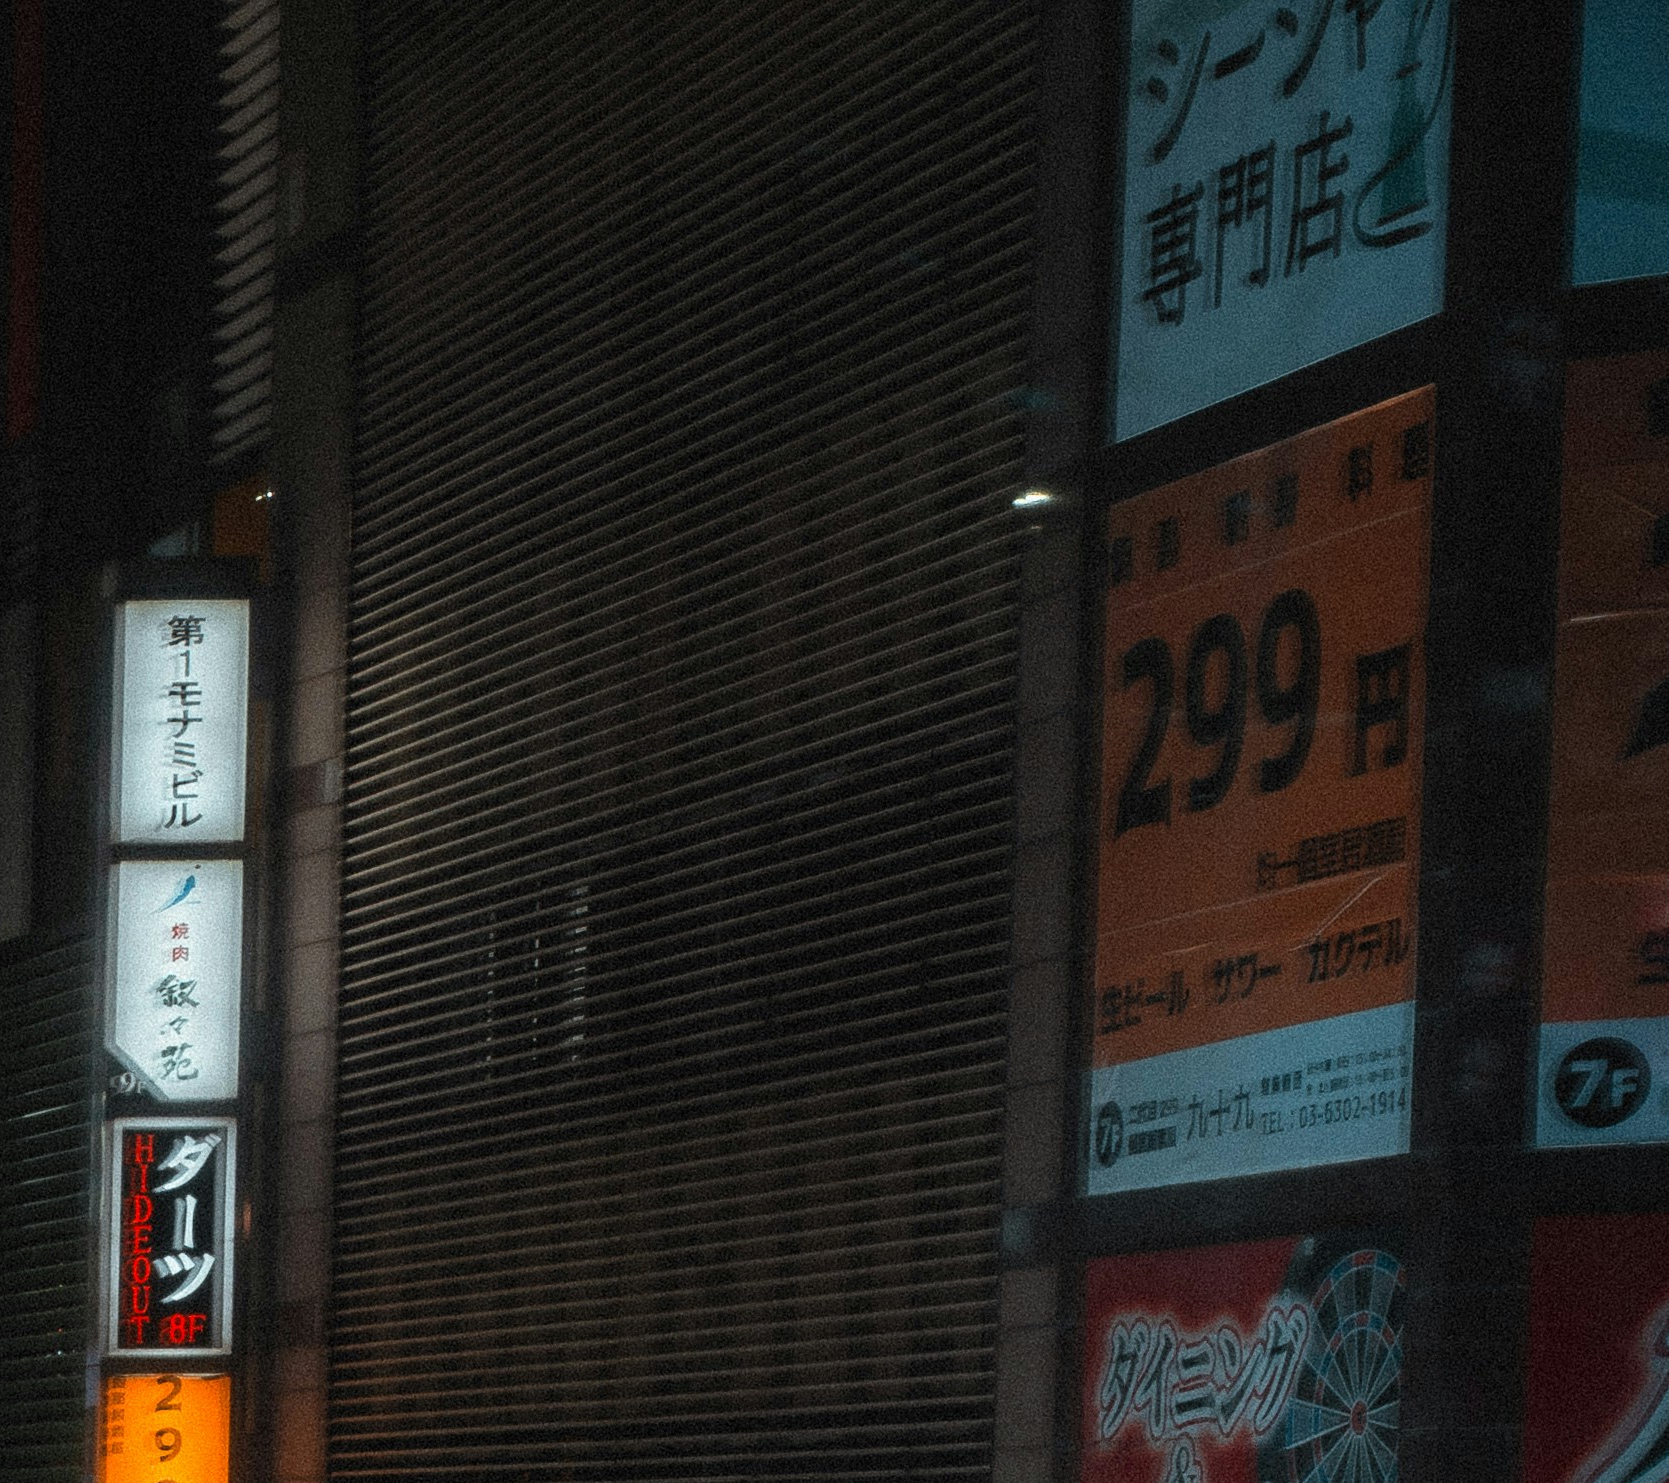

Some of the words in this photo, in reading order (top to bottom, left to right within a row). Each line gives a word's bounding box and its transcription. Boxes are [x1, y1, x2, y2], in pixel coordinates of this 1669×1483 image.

[165, 615, 207, 829] 第1モナミビル
[170, 922, 190, 964] 焼肉
[1211, 951, 1283, 1004] サワー
[1304, 917, 1415, 984] カクテル
[154, 973, 201, 1083] 叙々苑
[1185, 1082, 1258, 1141] 九十九
[1564, 1058, 1644, 1111] 7F
[131, 1133, 156, 1346] HIDEOUT
[152, 1133, 223, 1304] ダーツ
[168, 1313, 208, 1346] 8F
[1098, 1303, 1311, 1443] ダイニング
